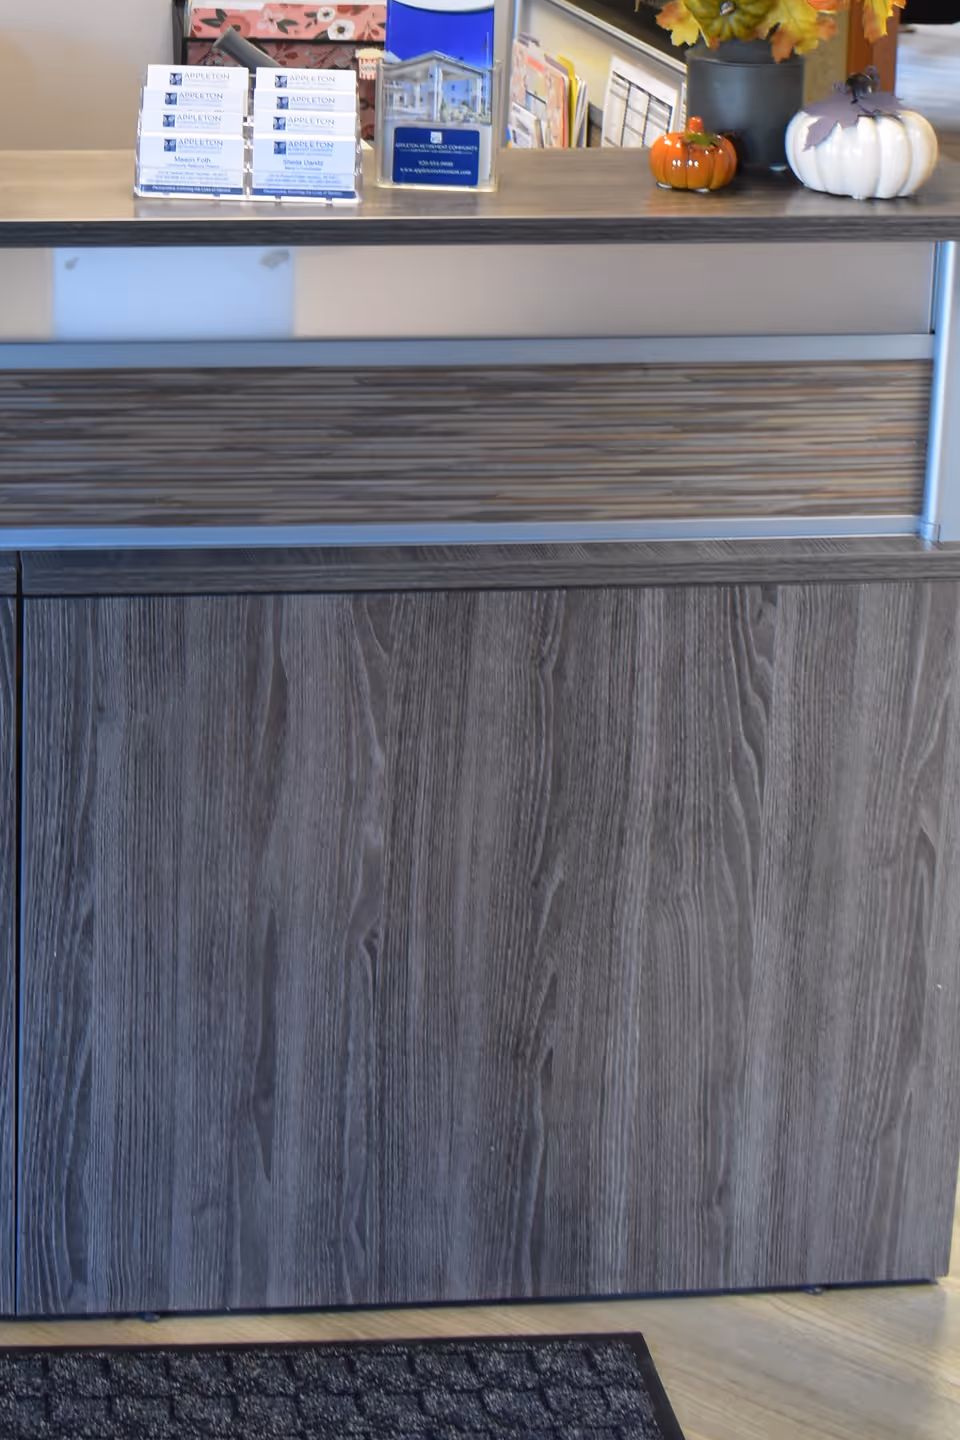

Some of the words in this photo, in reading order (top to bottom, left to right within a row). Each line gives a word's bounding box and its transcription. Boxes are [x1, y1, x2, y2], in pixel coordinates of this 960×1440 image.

[184, 72, 230, 81] APPLETON
[289, 74, 336, 83] APPLETON
[179, 92, 224, 100] APPLETON
[290, 96, 336, 104] APPLETON
[176, 114, 222, 122] APPLETON
[288, 116, 335, 125] APPLETON
[178, 138, 224, 147] APPLETON
[288, 140, 334, 148] APPLETON
